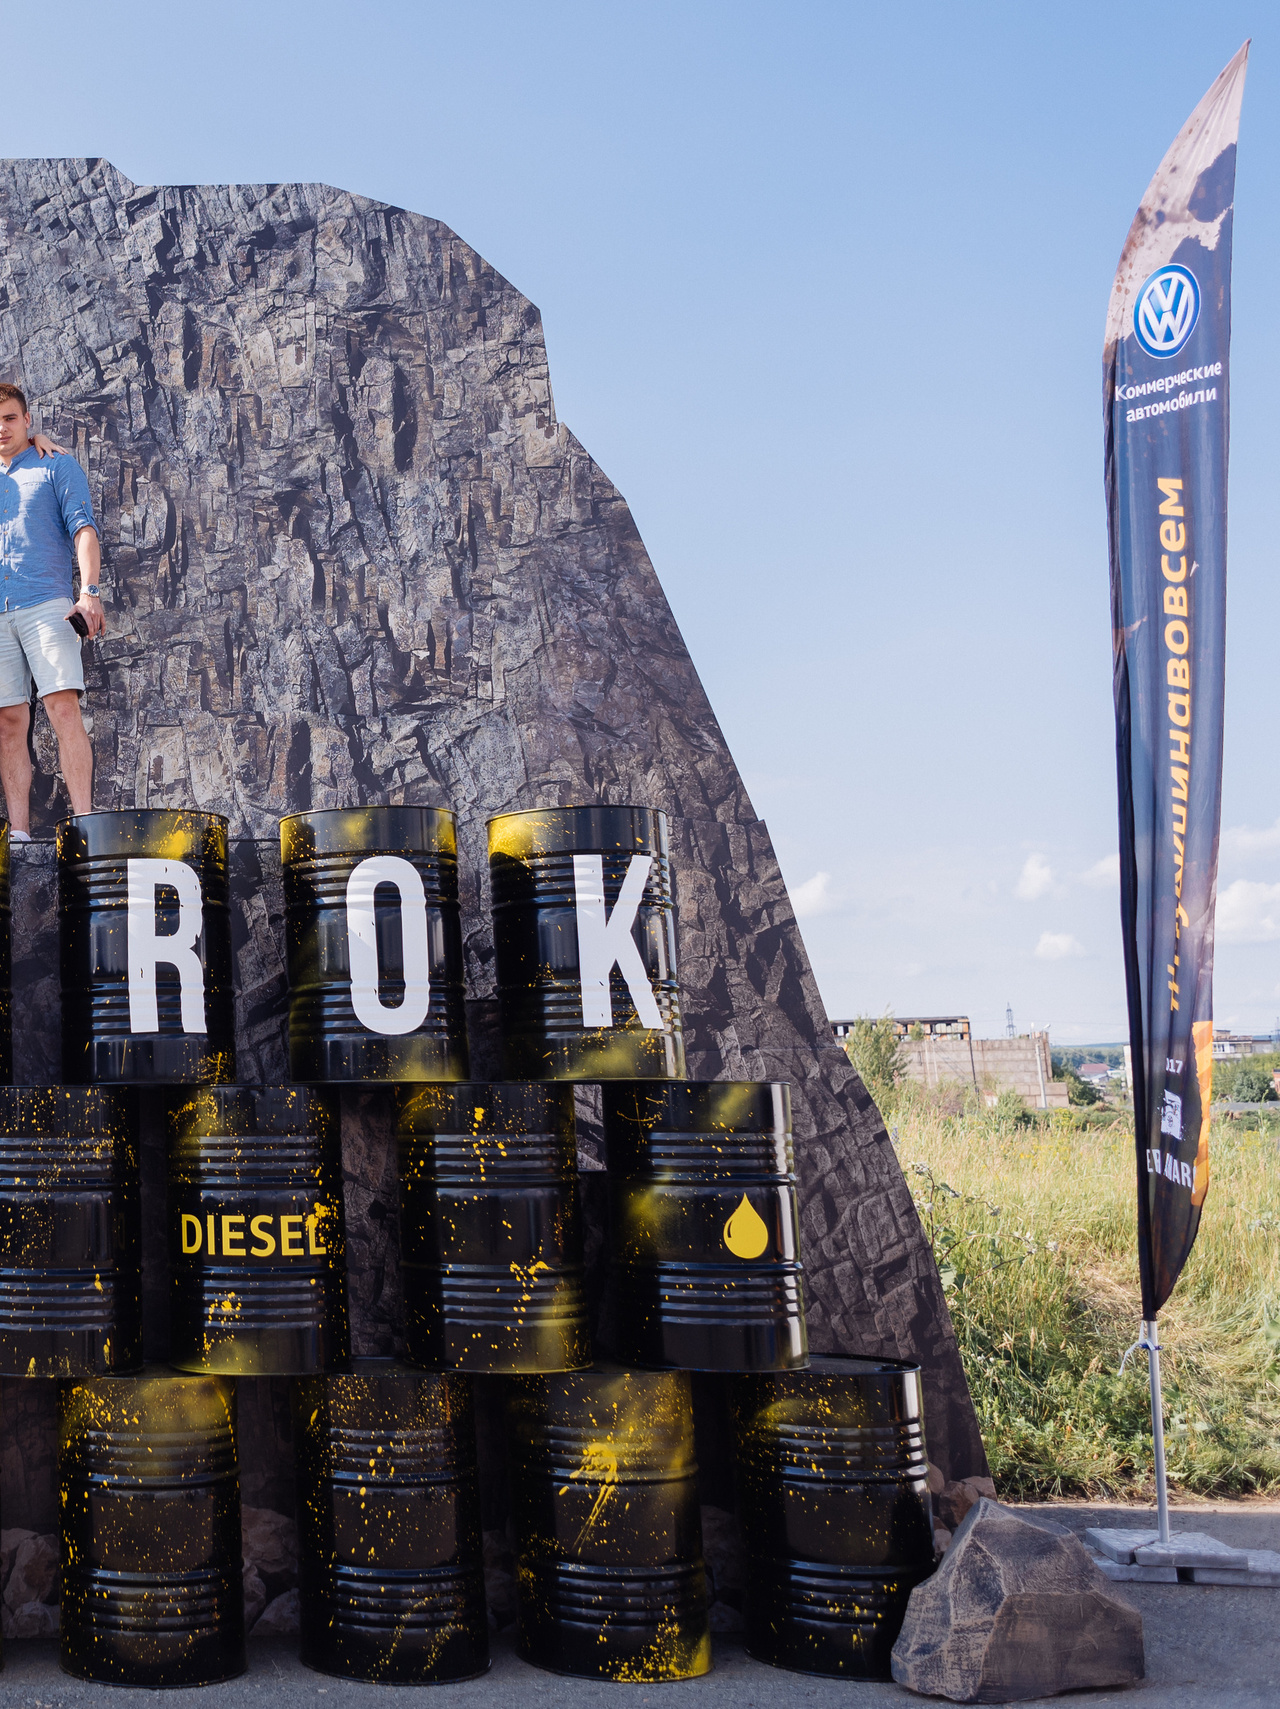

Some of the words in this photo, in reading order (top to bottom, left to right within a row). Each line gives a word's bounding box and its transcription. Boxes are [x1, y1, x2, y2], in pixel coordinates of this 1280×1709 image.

[1115, 361, 1222, 401] Коммерческие
[1126, 387, 1217, 422] автомобили
[181, 1213, 327, 1257] DIESEL
